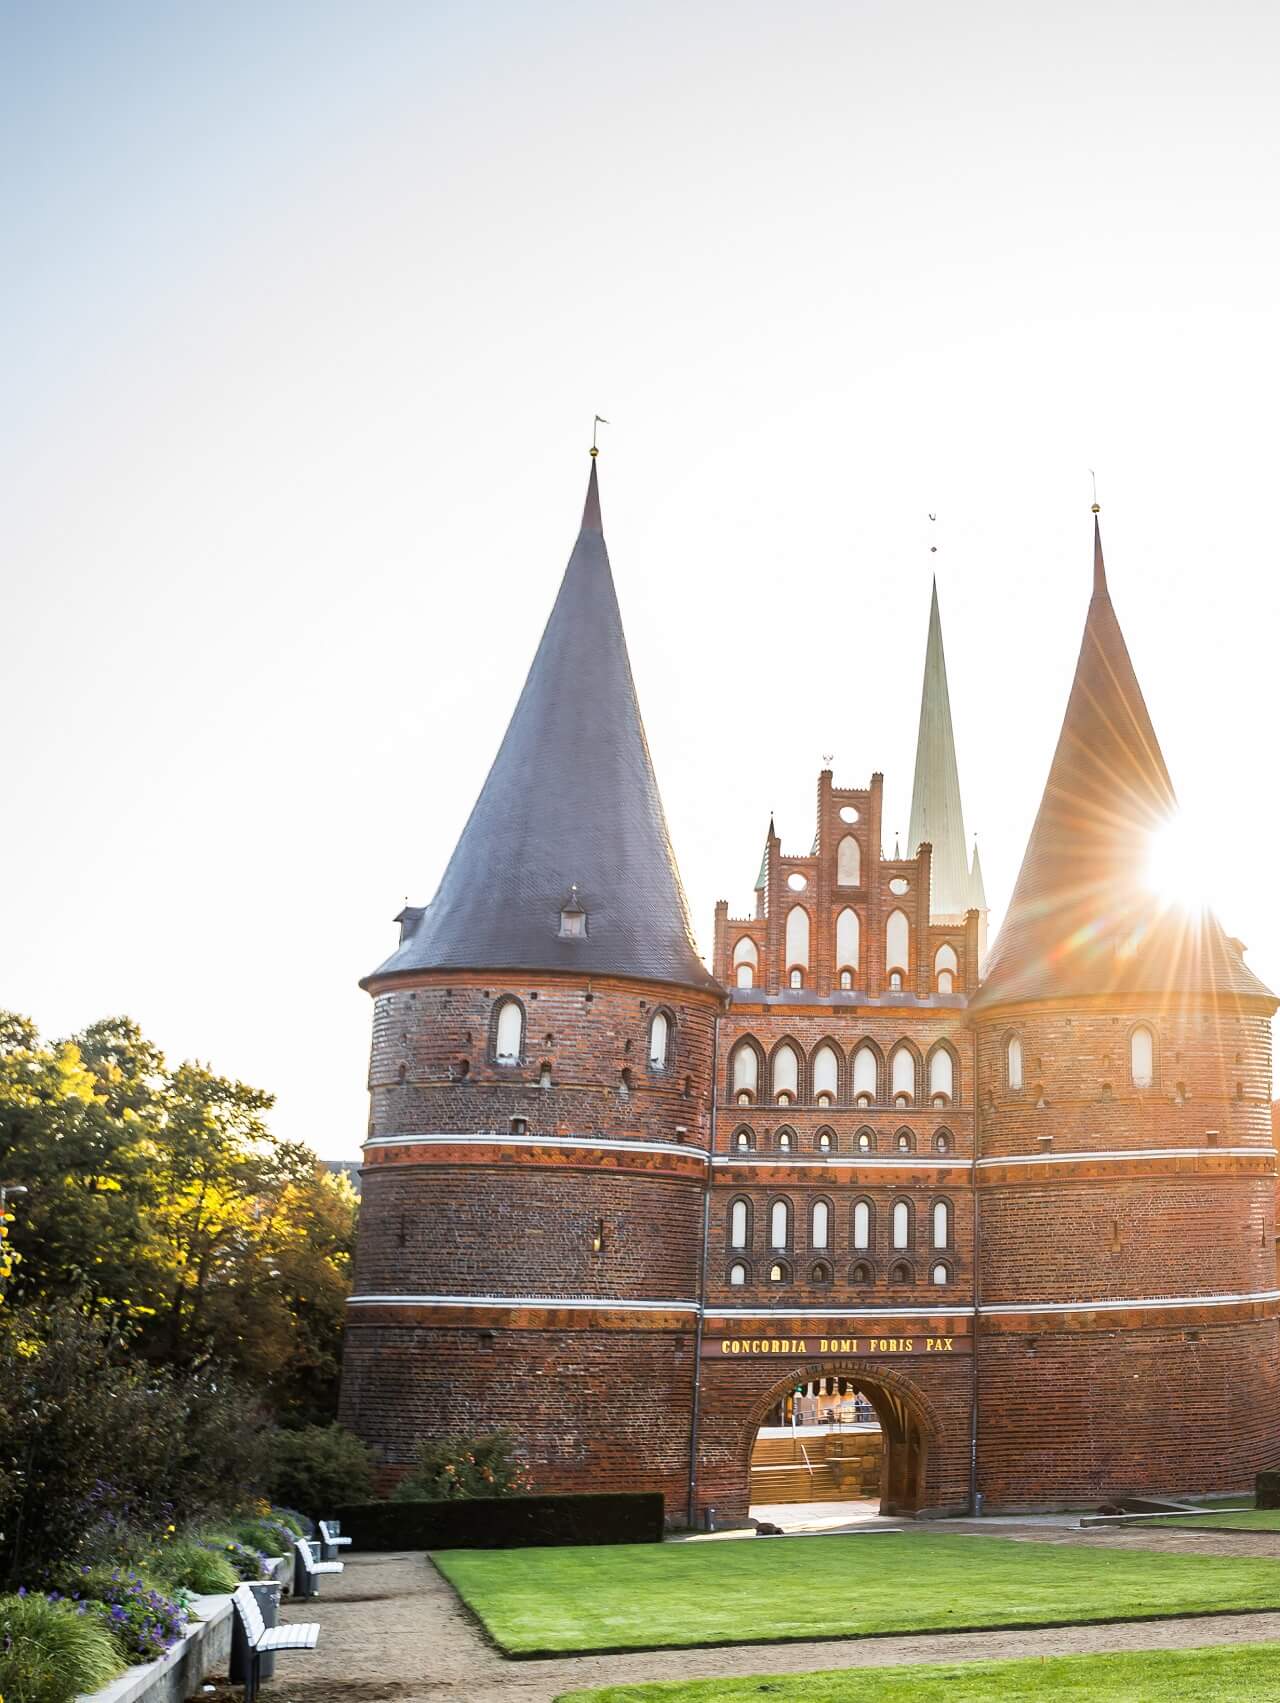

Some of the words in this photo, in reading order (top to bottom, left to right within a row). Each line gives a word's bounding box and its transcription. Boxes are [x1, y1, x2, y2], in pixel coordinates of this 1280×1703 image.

[721, 1339, 807, 1354] CONCORDIA
[820, 1339, 858, 1353] DOMI
[870, 1338, 913, 1352] FORIS
[926, 1338, 953, 1352] PAX
